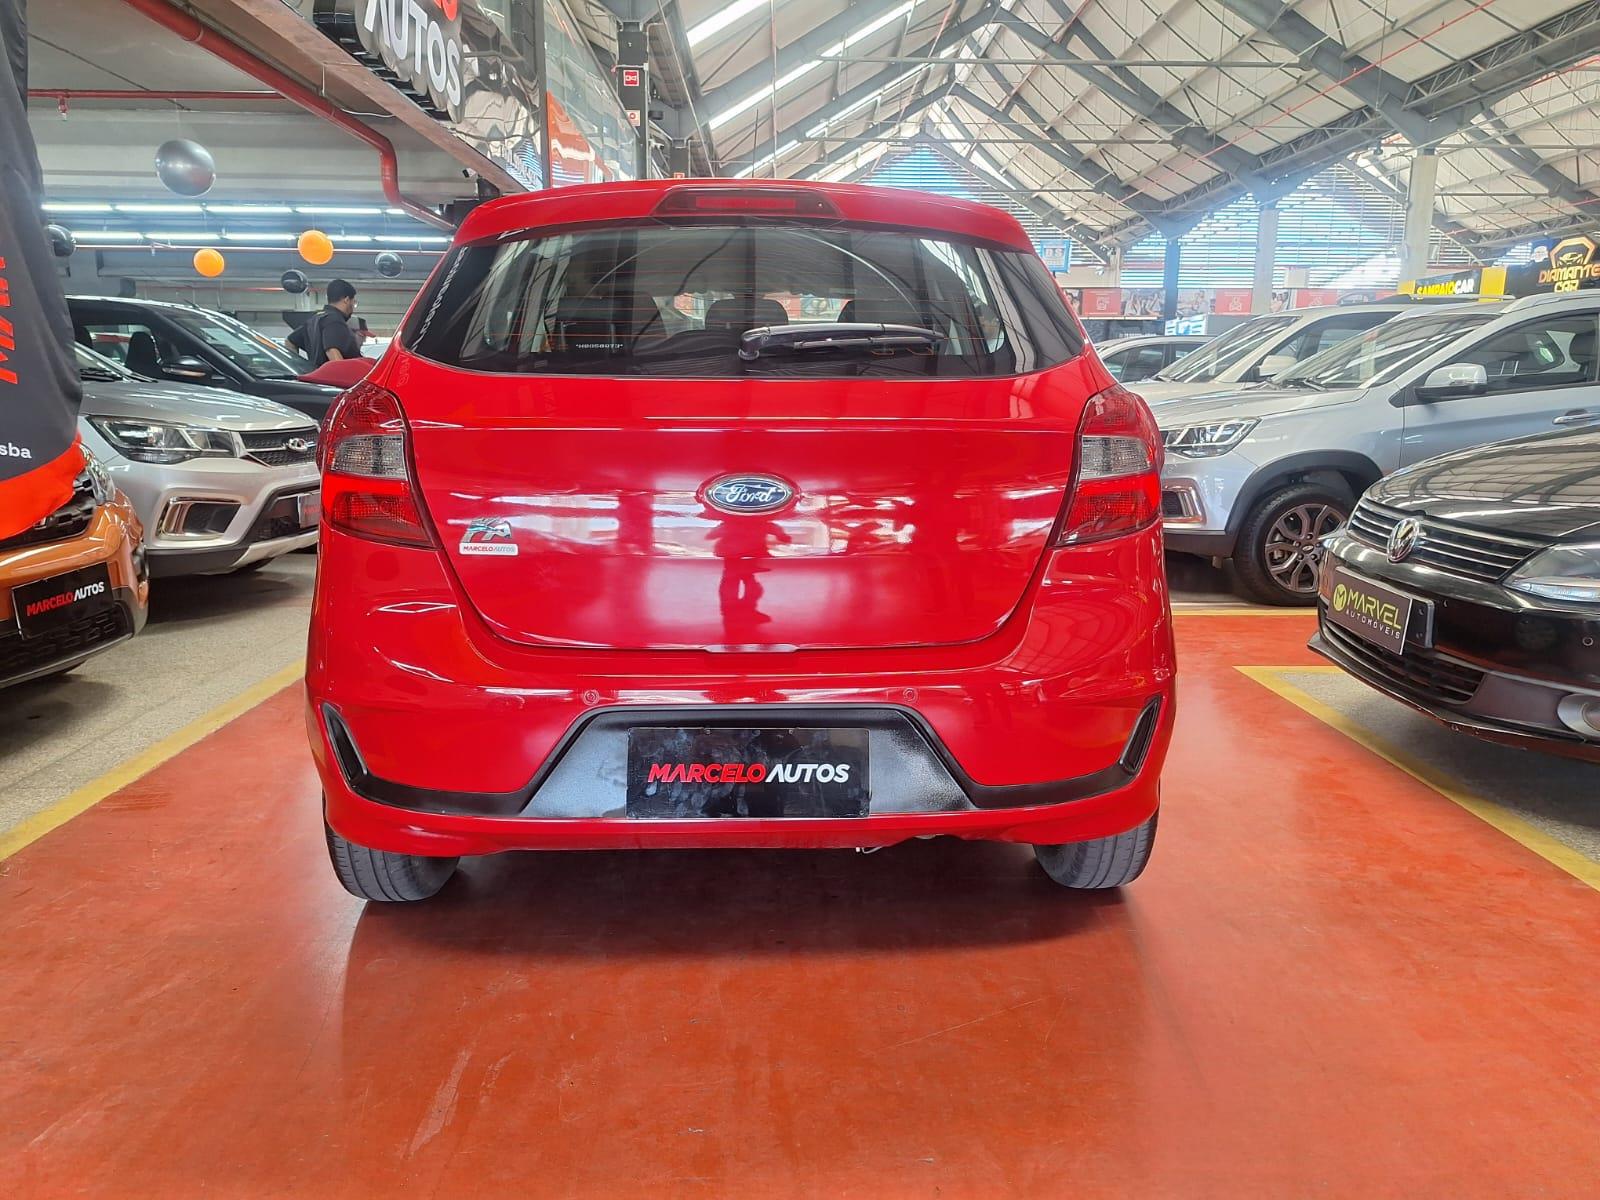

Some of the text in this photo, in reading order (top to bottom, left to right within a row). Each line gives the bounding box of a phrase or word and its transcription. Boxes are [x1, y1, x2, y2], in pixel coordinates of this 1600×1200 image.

[364, 0, 460, 106] AUTOS
[1538, 263, 1600, 284] DIAMANTE
[1554, 279, 1579, 293] CAR
[0, 442, 33, 459] sba
[719, 483, 777, 503] Ford
[1347, 588, 1402, 629] MARVEL
